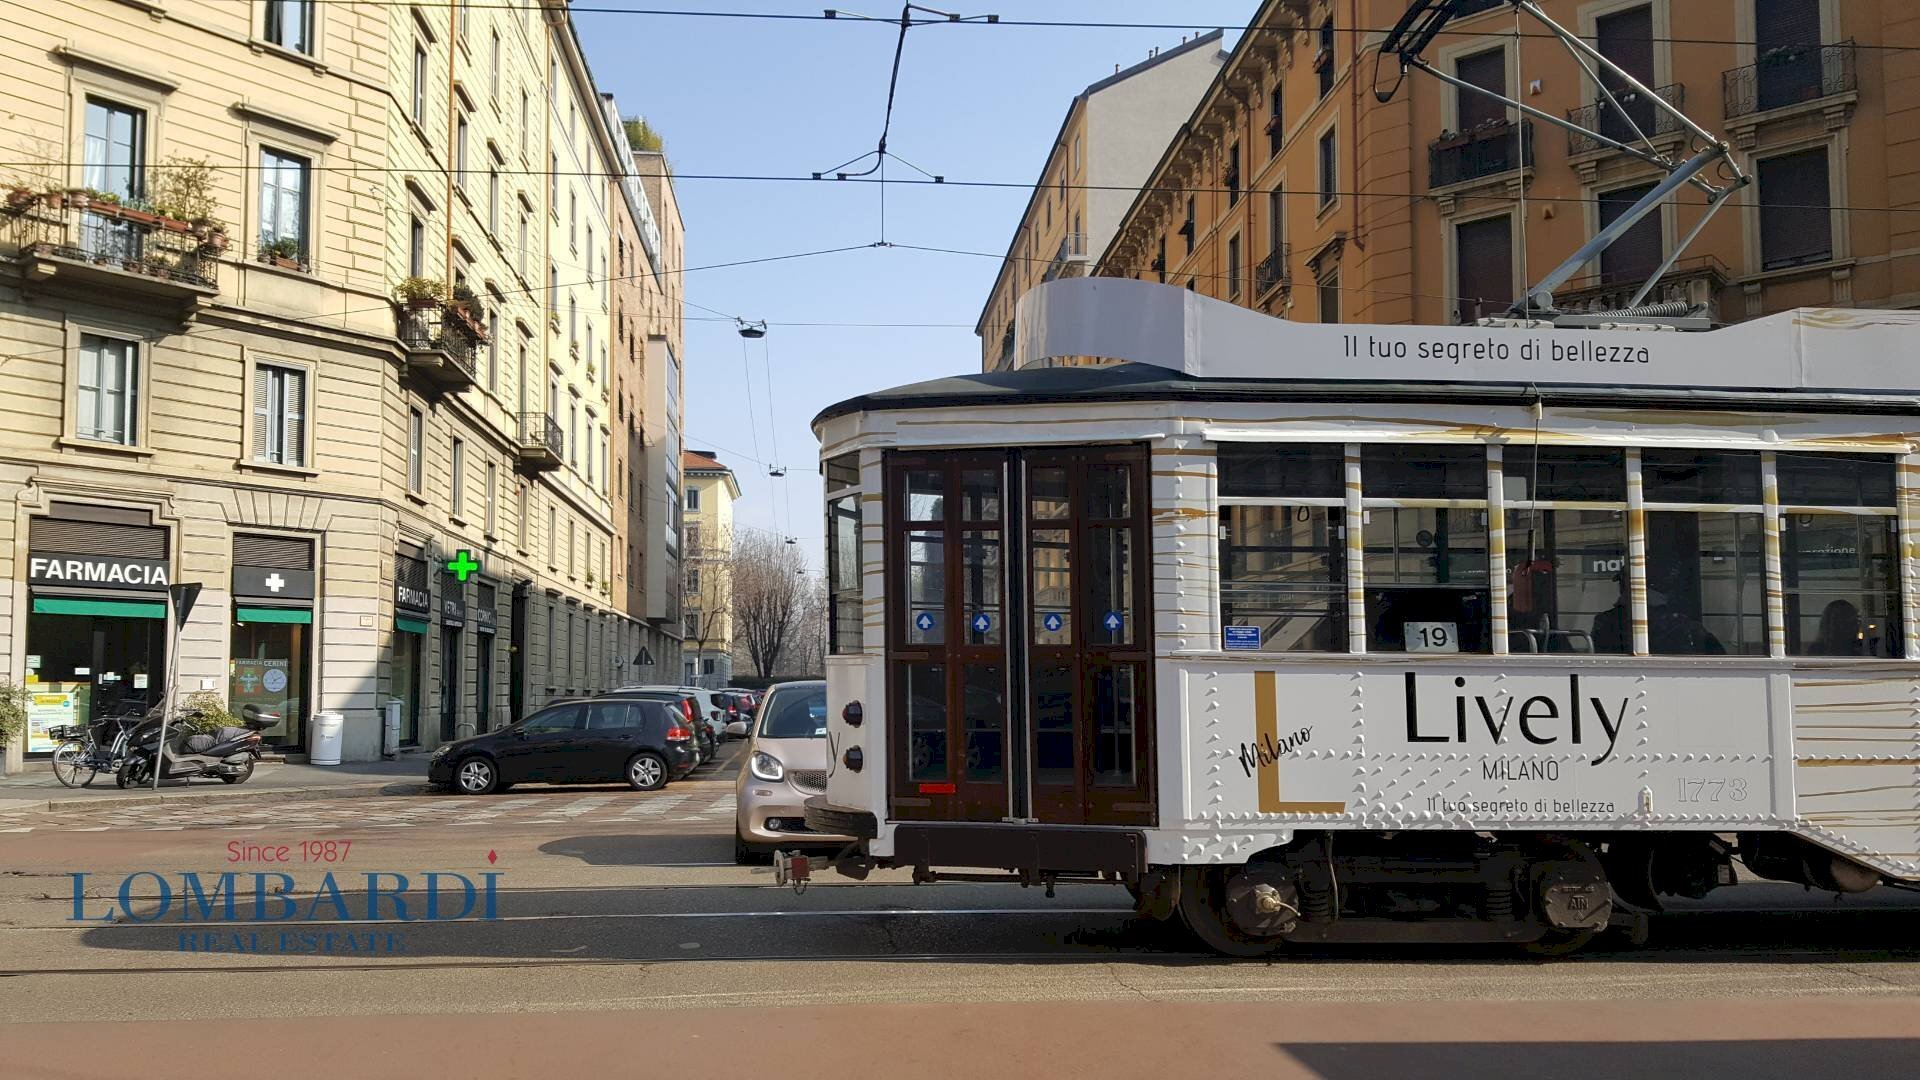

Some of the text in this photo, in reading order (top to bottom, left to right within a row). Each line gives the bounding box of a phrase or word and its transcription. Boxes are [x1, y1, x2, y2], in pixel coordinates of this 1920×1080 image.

[1368, 335, 1407, 358] tuo
[1418, 337, 1509, 364] segreto
[1520, 338, 1541, 361] di
[1551, 339, 1650, 364] bellezza
[30, 557, 168, 586] FARMACIA
[398, 586, 428, 607] FARMACIA
[1419, 627, 1447, 647] 19
[1405, 672, 1629, 767] Lively
[1239, 726, 1313, 778] Milano
[1482, 760, 1560, 781] MILANO
[1678, 777, 1748, 803] 1773
[1442, 797, 1467, 812] tuo
[1472, 798, 1529, 816] segreto
[1534, 798, 1548, 813] di
[1553, 799, 1615, 814] bellezza
